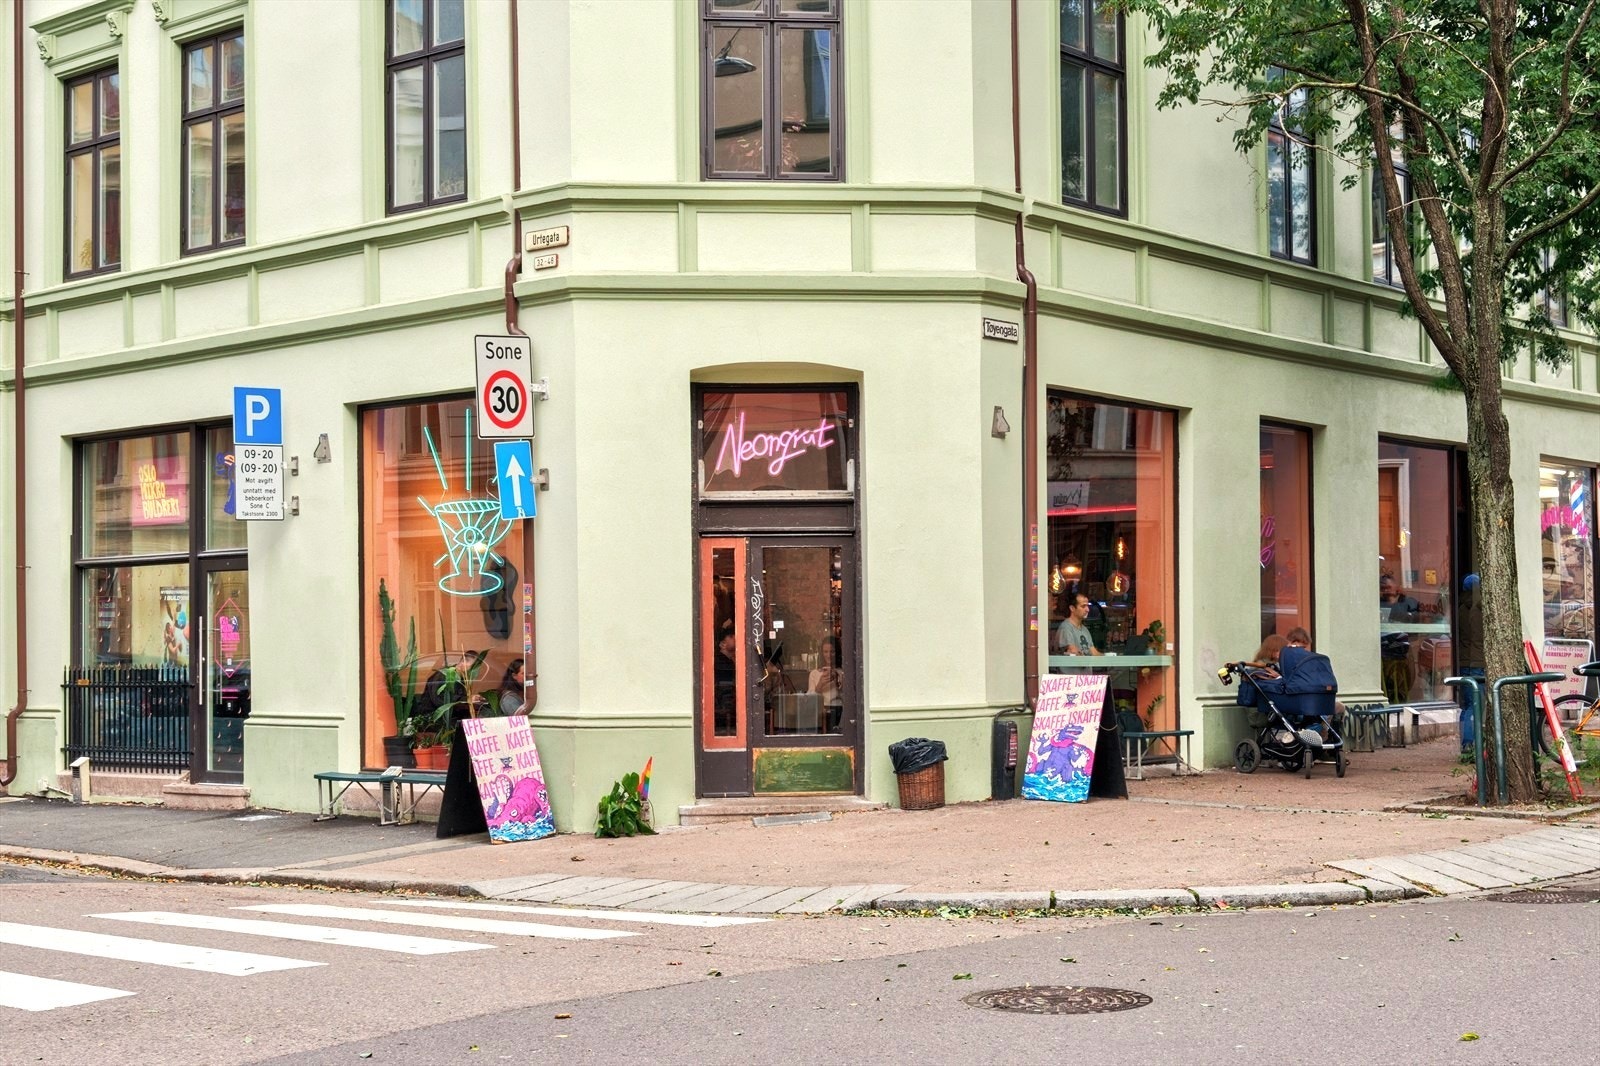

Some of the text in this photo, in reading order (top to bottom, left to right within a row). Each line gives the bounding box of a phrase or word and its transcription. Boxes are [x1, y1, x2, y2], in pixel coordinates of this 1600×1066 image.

[532, 232, 559, 246] Urtegata
[485, 341, 522, 359] Sone
[492, 386, 520, 413] 30
[245, 394, 271, 437] P
[715, 411, 835, 475] Neongrut
[139, 464, 156, 482] OSLO
[257, 477, 274, 485] avgift
[468, 735, 501, 757] KAFFE
